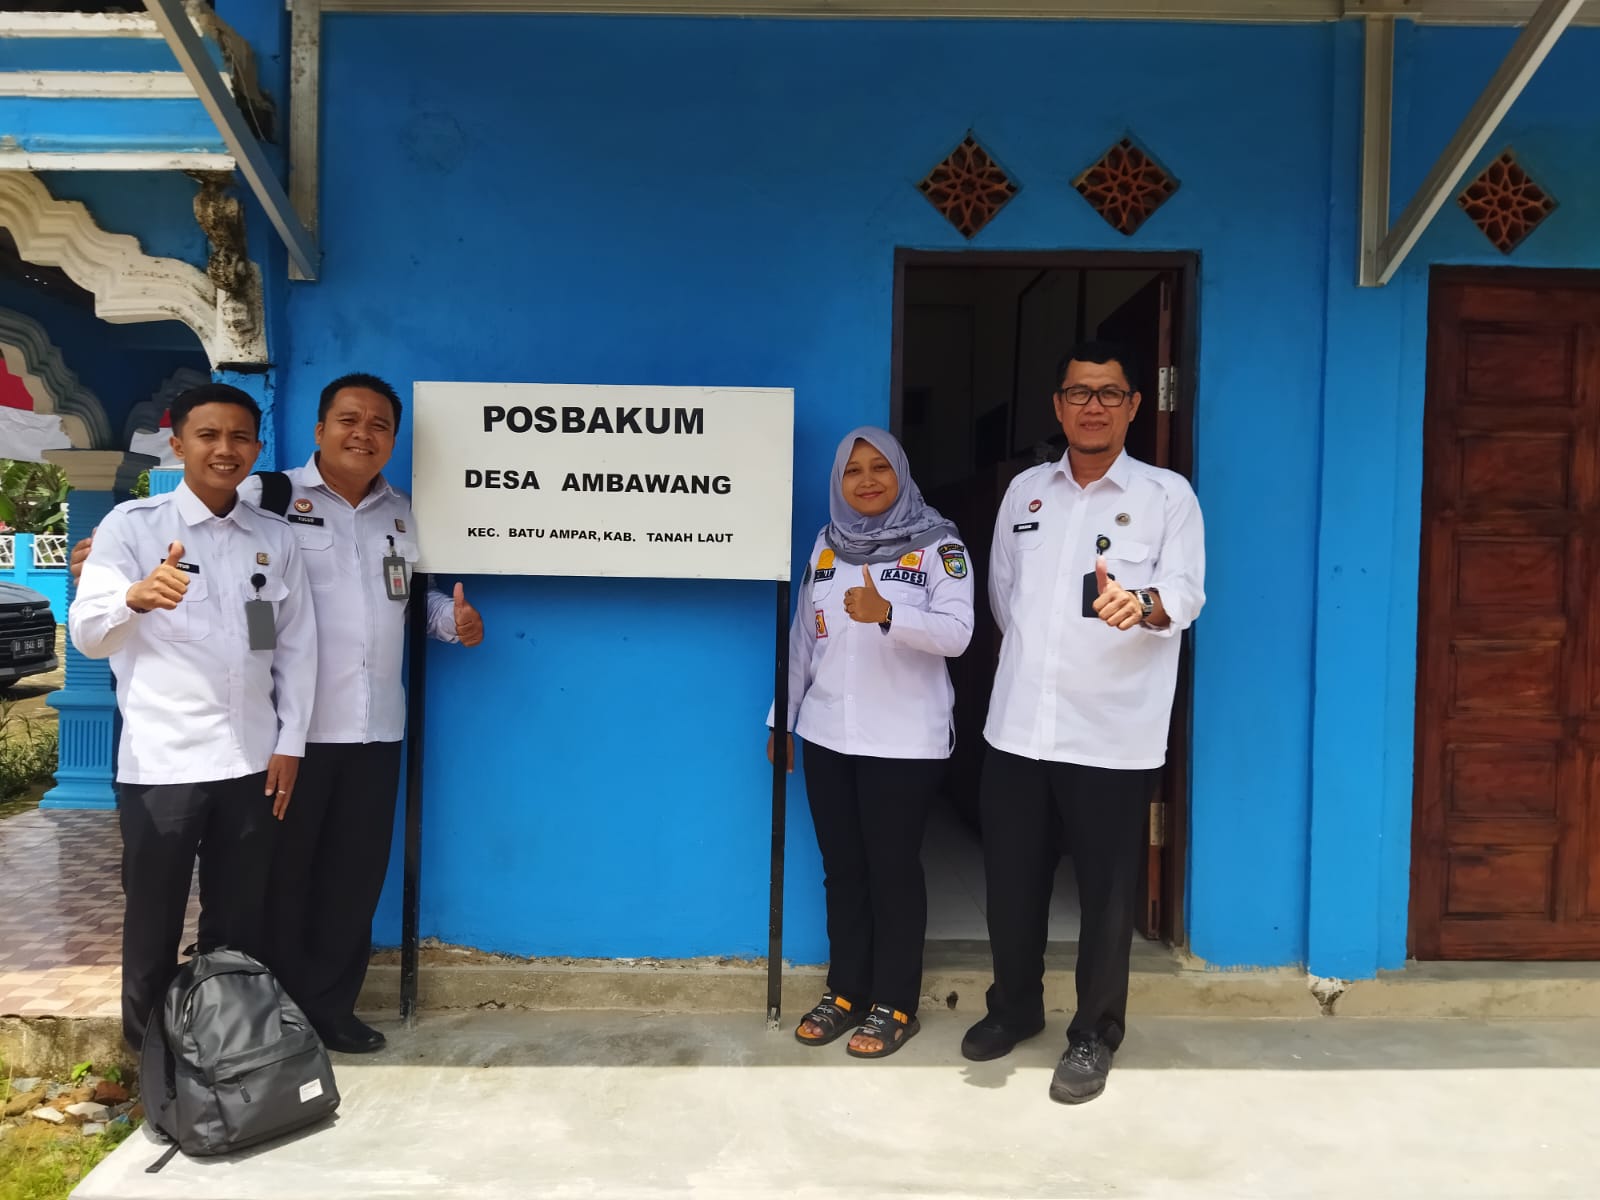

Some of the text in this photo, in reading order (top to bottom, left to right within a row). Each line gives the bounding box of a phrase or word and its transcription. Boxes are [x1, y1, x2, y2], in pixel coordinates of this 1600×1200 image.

[483, 405, 704, 435] POSBAKUM
[464, 469, 732, 495] DESA AMBAWANG
[467, 527, 500, 538] KEC.
[508, 527, 545, 539] BATU
[603, 531, 636, 542] KAB.
[646, 532, 693, 543] TANAH
[697, 533, 734, 543] LAUT
[885, 569, 924, 584] KADES
